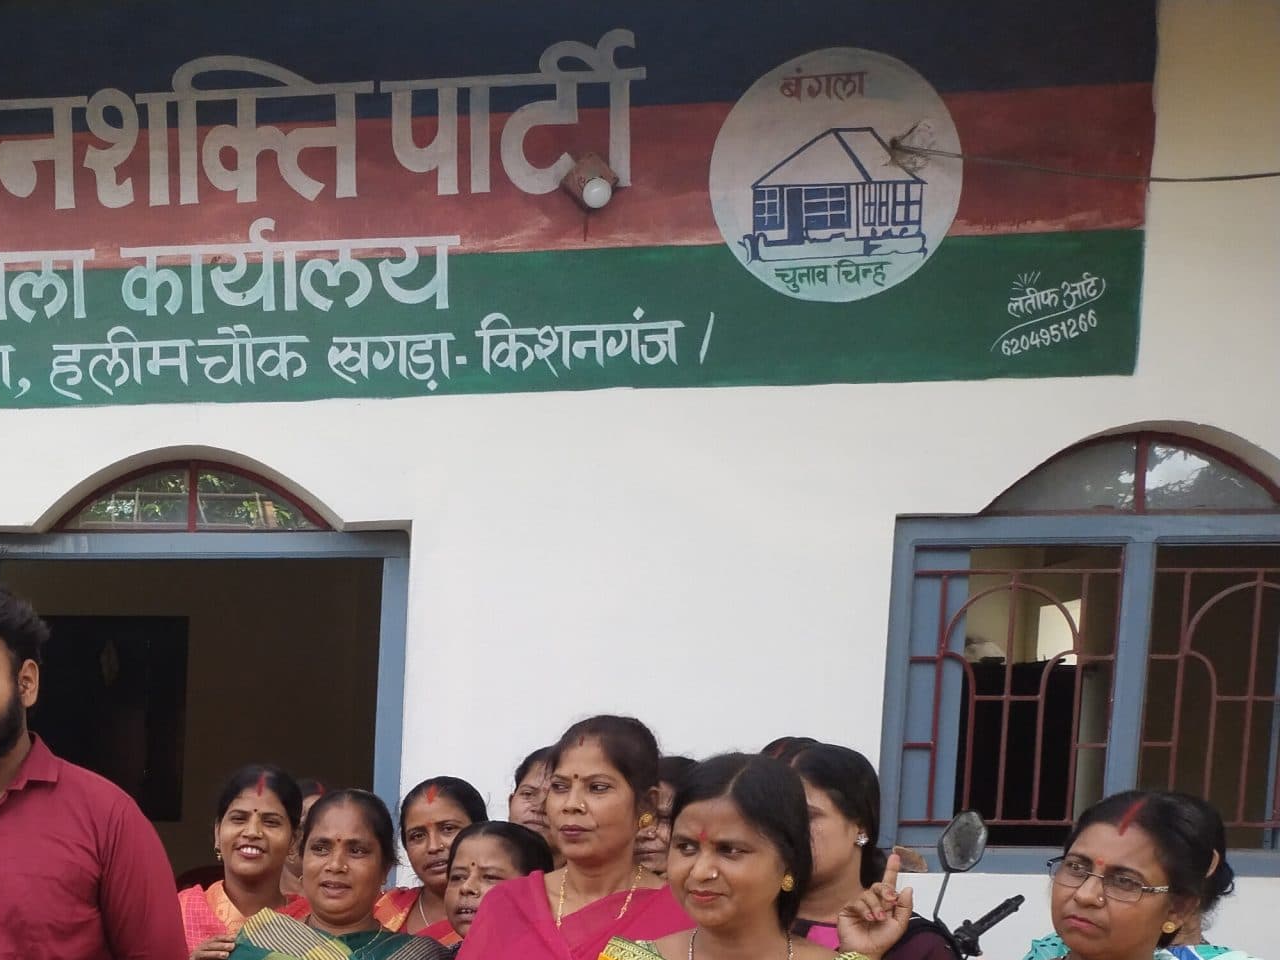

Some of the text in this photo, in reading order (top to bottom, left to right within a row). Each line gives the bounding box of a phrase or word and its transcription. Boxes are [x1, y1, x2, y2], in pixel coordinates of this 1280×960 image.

[780, 67, 868, 103] बंगला
[380, 28, 647, 196] पार्टी
[120, 217, 460, 315] कार्यालय
[774, 259, 893, 293] चुनाव चिन्ह
[1007, 272, 1100, 318] लतीफ आर्ट
[49, 326, 196, 401] हलीम
[196, 324, 310, 385] चौक
[475, 306, 685, 378] किशनगंज
[1001, 309, 1097, 356] 6204951266
